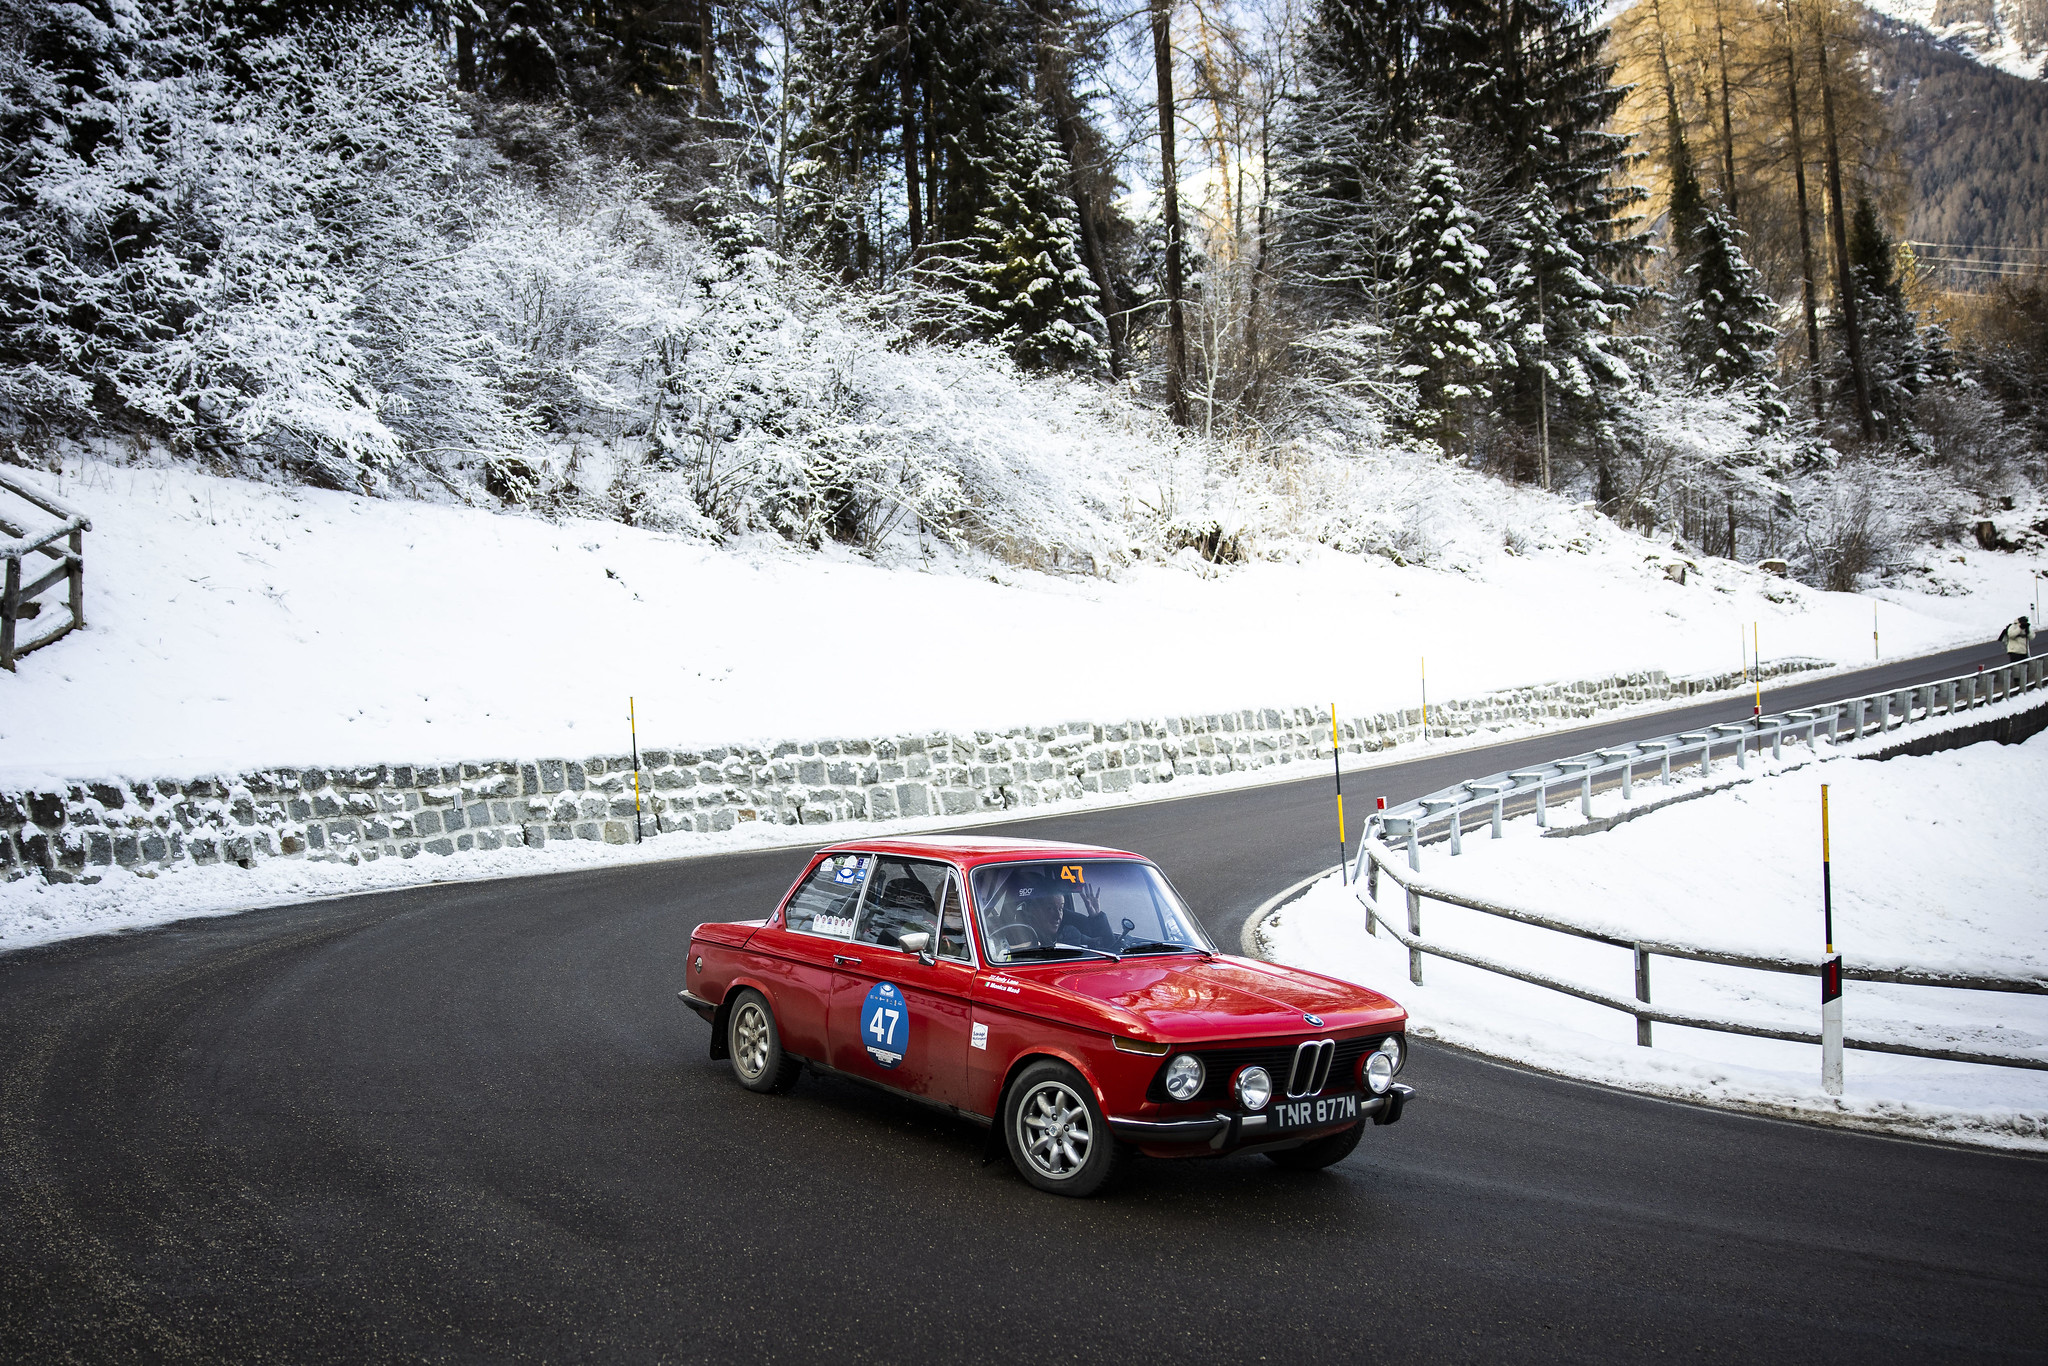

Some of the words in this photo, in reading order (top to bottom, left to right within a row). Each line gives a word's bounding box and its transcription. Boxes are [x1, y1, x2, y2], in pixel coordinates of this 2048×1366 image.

[1060, 865, 1085, 883] 47
[869, 1006, 900, 1045] 47
[1275, 1102, 1312, 1127] TNR
[1316, 1095, 1356, 1122] 877M
